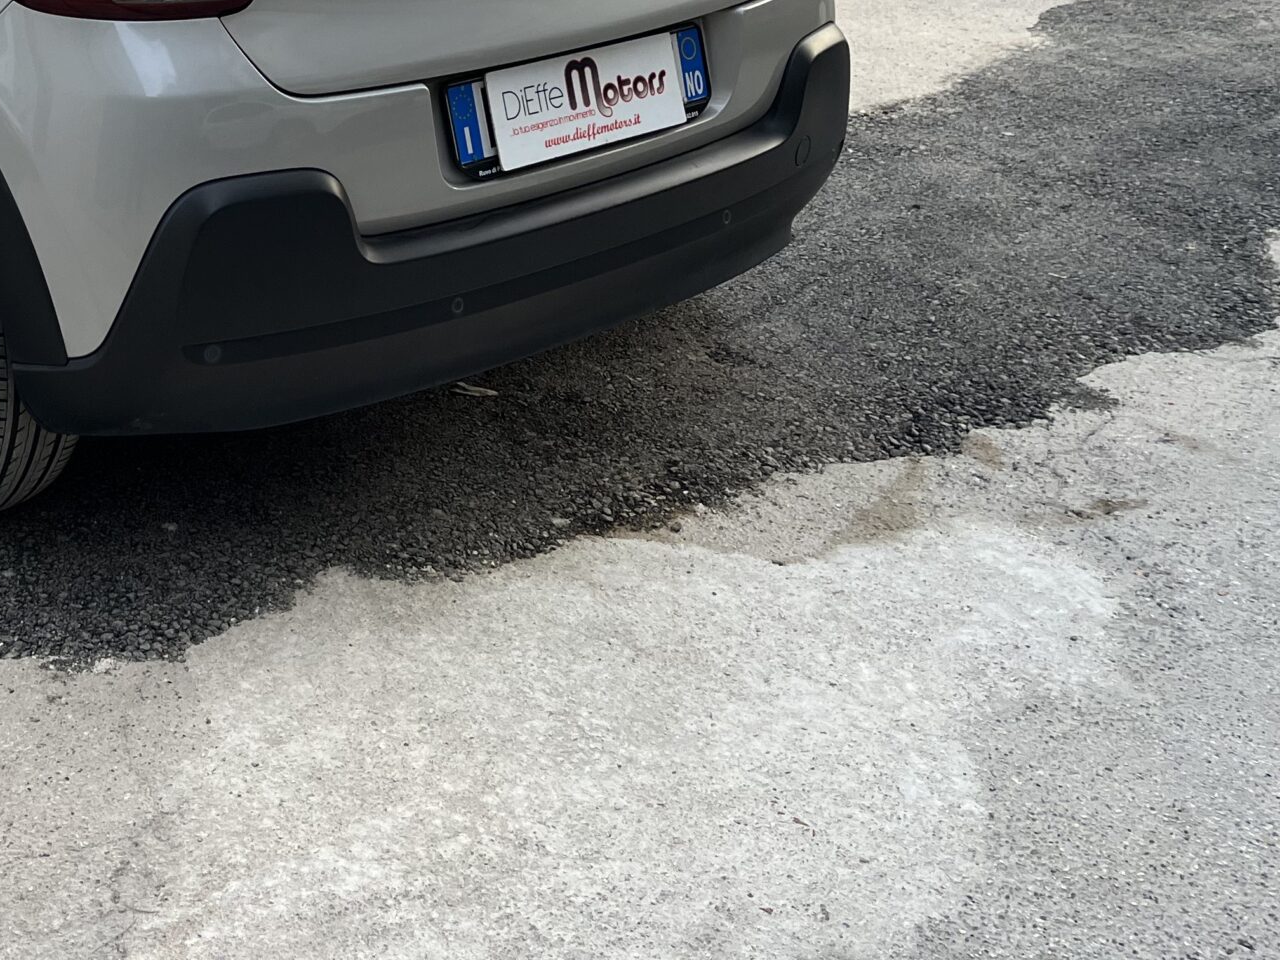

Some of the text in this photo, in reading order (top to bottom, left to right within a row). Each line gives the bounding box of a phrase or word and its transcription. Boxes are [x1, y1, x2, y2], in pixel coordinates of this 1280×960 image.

[502, 57, 666, 120] DiEffe Motors
[684, 70, 704, 98] NO
[545, 113, 642, 148] www.dieffemotors.it
